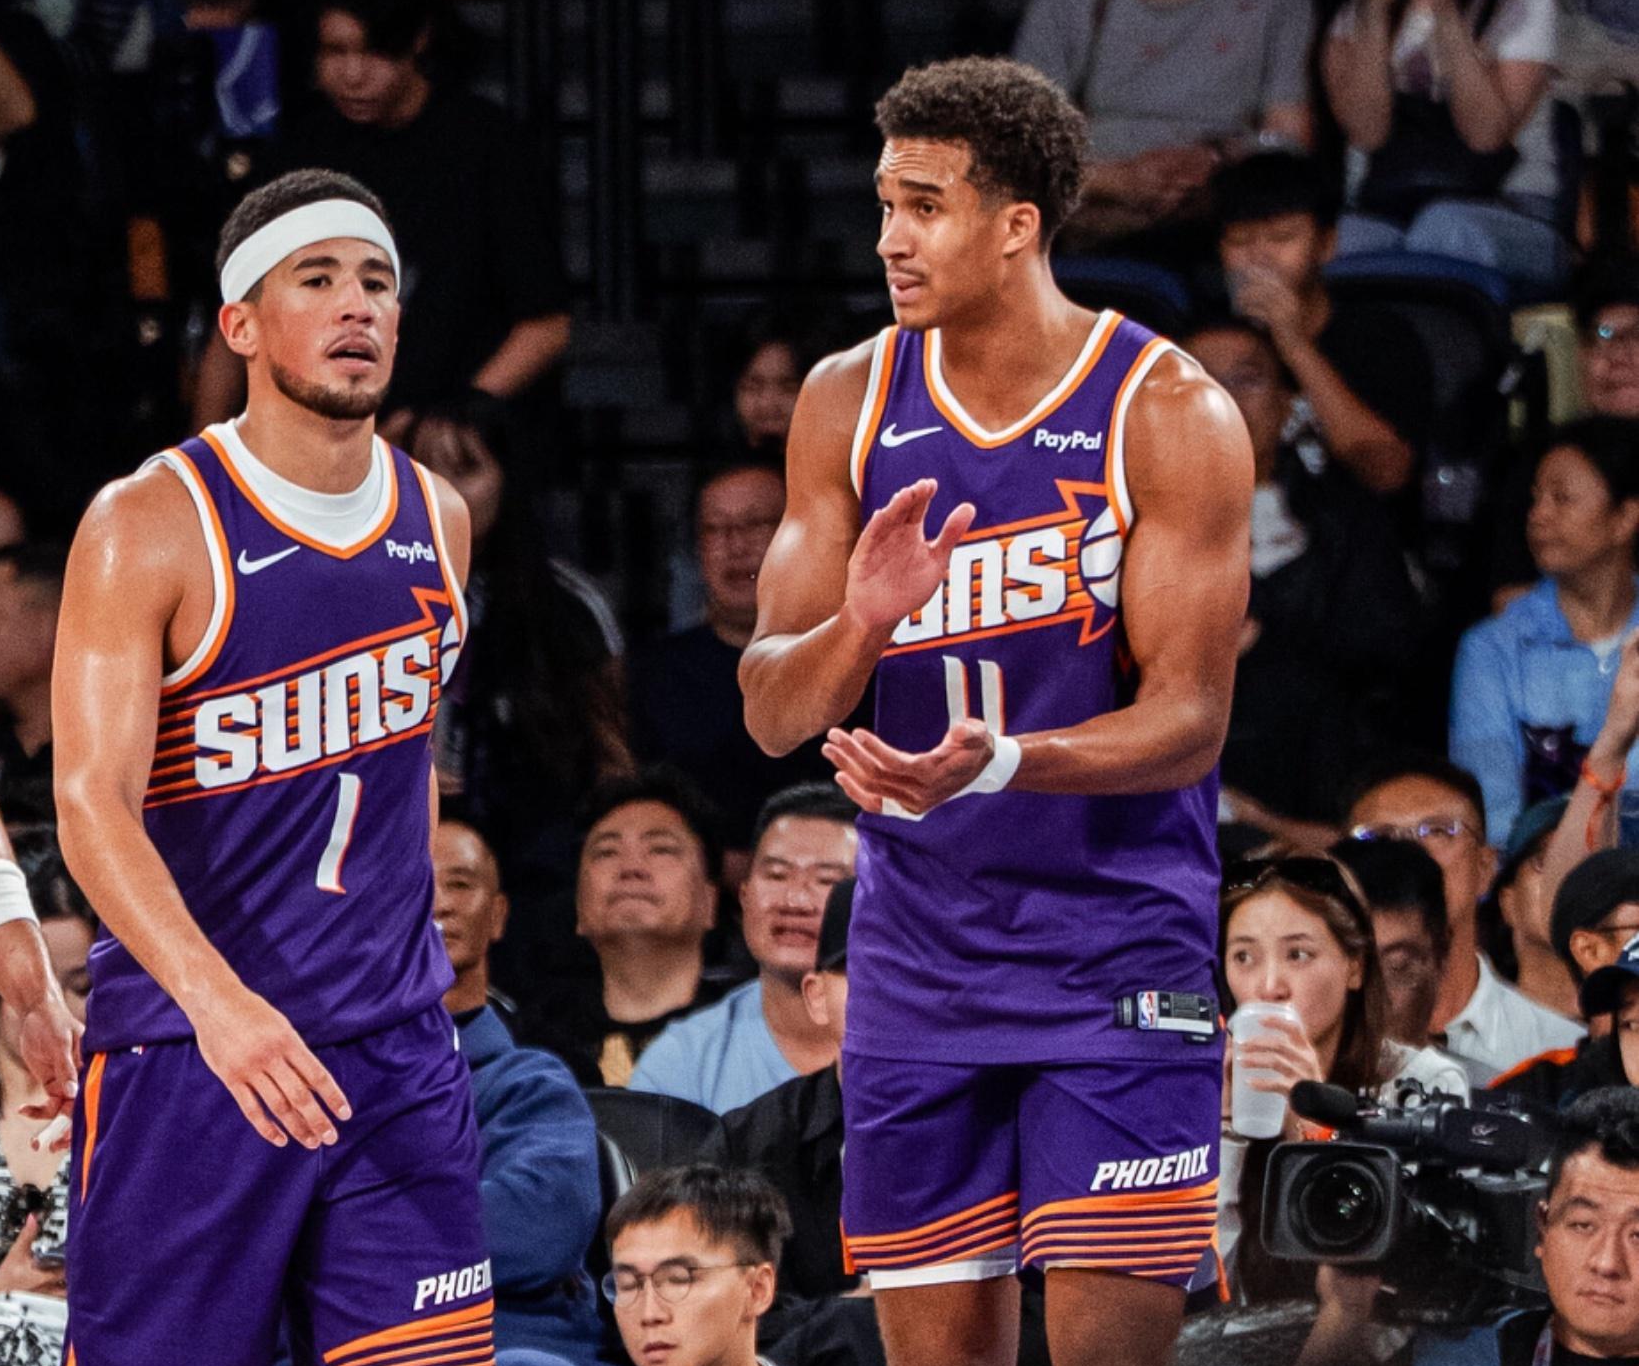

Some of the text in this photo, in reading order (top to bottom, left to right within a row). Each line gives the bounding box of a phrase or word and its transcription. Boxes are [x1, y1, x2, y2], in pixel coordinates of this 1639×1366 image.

[1034, 428, 1102, 453] PayPal
[385, 539, 436, 564] PayPal
[194, 635, 431, 789] SUNS
[316, 773, 362, 894] 1
[1089, 1143, 1210, 1192] PHOENIX
